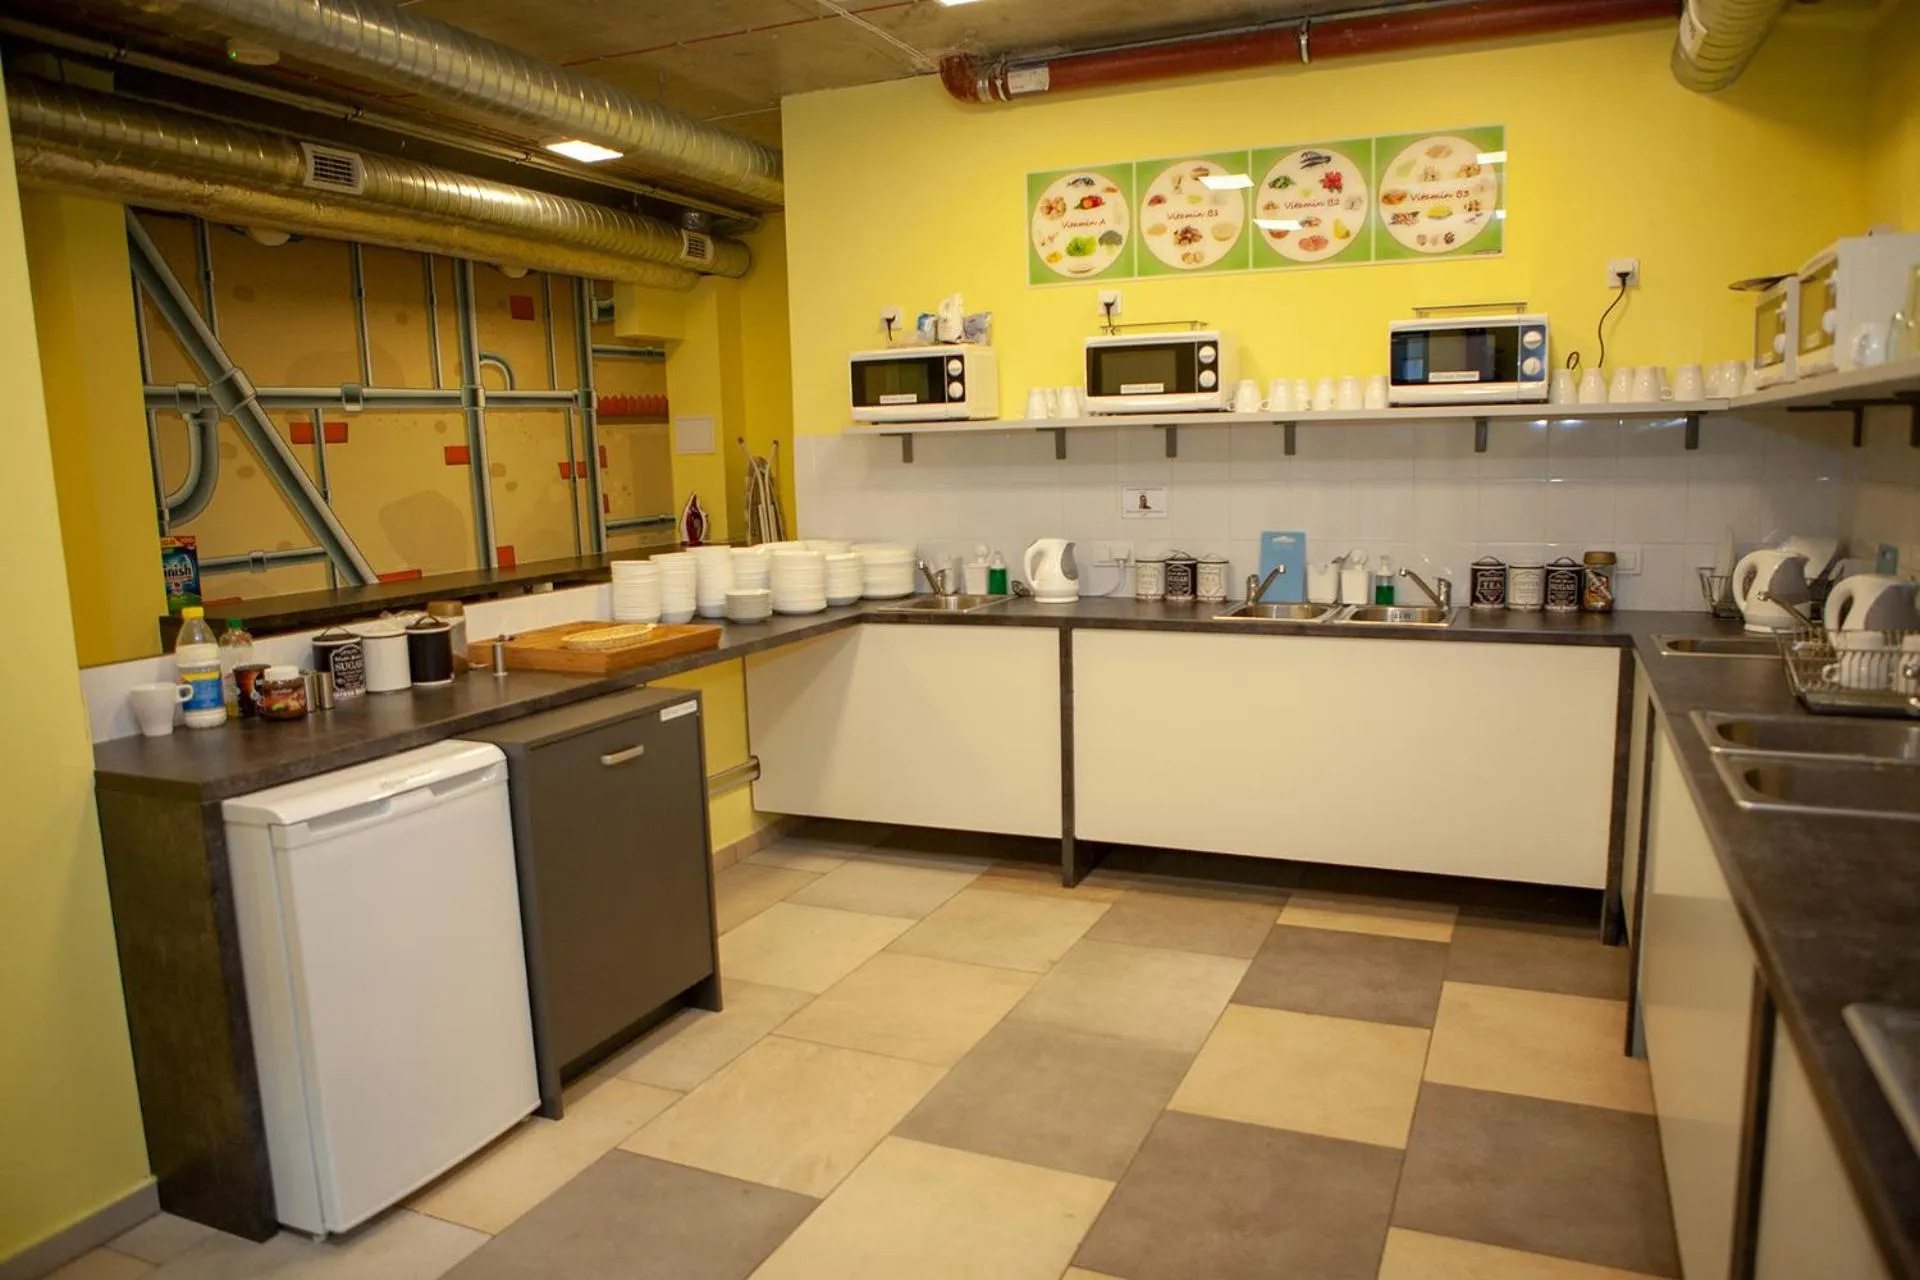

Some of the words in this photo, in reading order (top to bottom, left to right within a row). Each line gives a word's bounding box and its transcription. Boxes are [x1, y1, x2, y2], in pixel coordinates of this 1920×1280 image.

[1410, 191, 1453, 201] Vitamin
[1284, 200, 1325, 210] Vitamin
[1327, 197, 1340, 207] B2
[1167, 211, 1205, 220] Vitamin
[1062, 218, 1098, 229] Vitamin
[1098, 217, 1106, 226] A
[163, 564, 192, 579] inish
